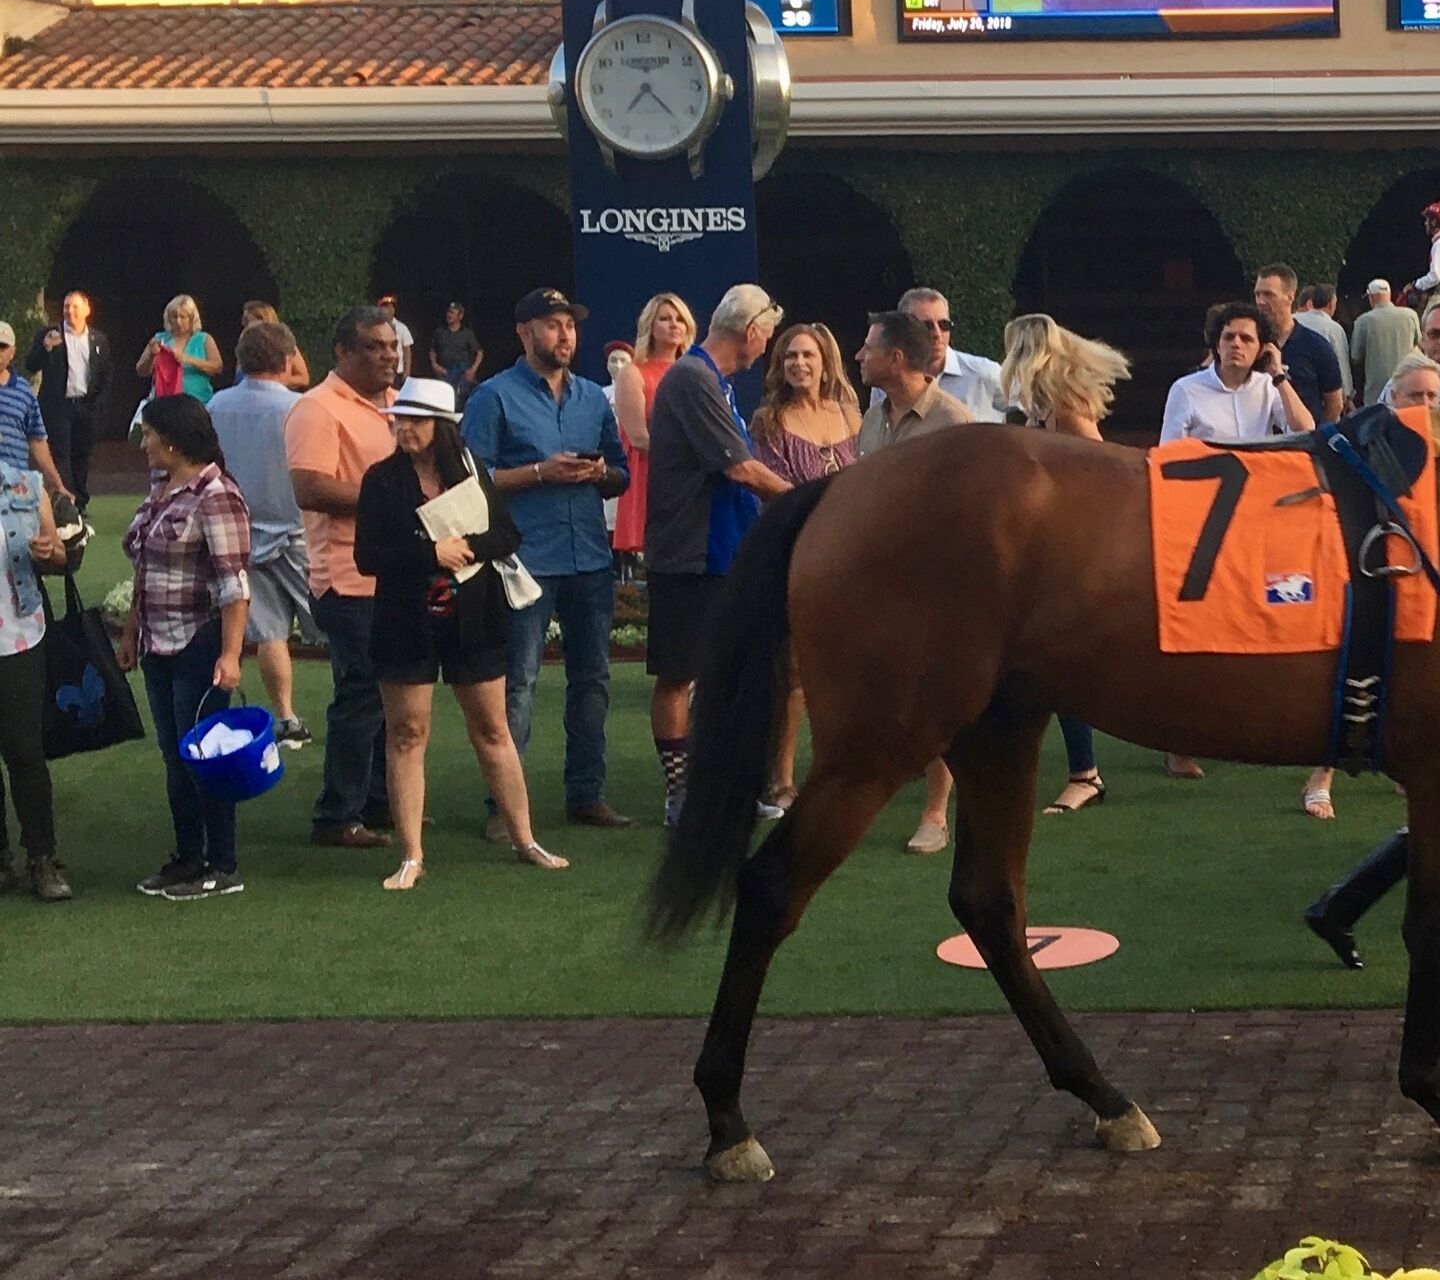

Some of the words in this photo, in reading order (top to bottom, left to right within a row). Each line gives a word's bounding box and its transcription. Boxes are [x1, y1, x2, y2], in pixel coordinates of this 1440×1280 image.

[782, 11, 811, 27] 30
[912, 17, 945, 33] Friday,
[615, 40, 624, 51] 11
[579, 207, 747, 233] LONGINES
[1161, 452, 1250, 602] 7
